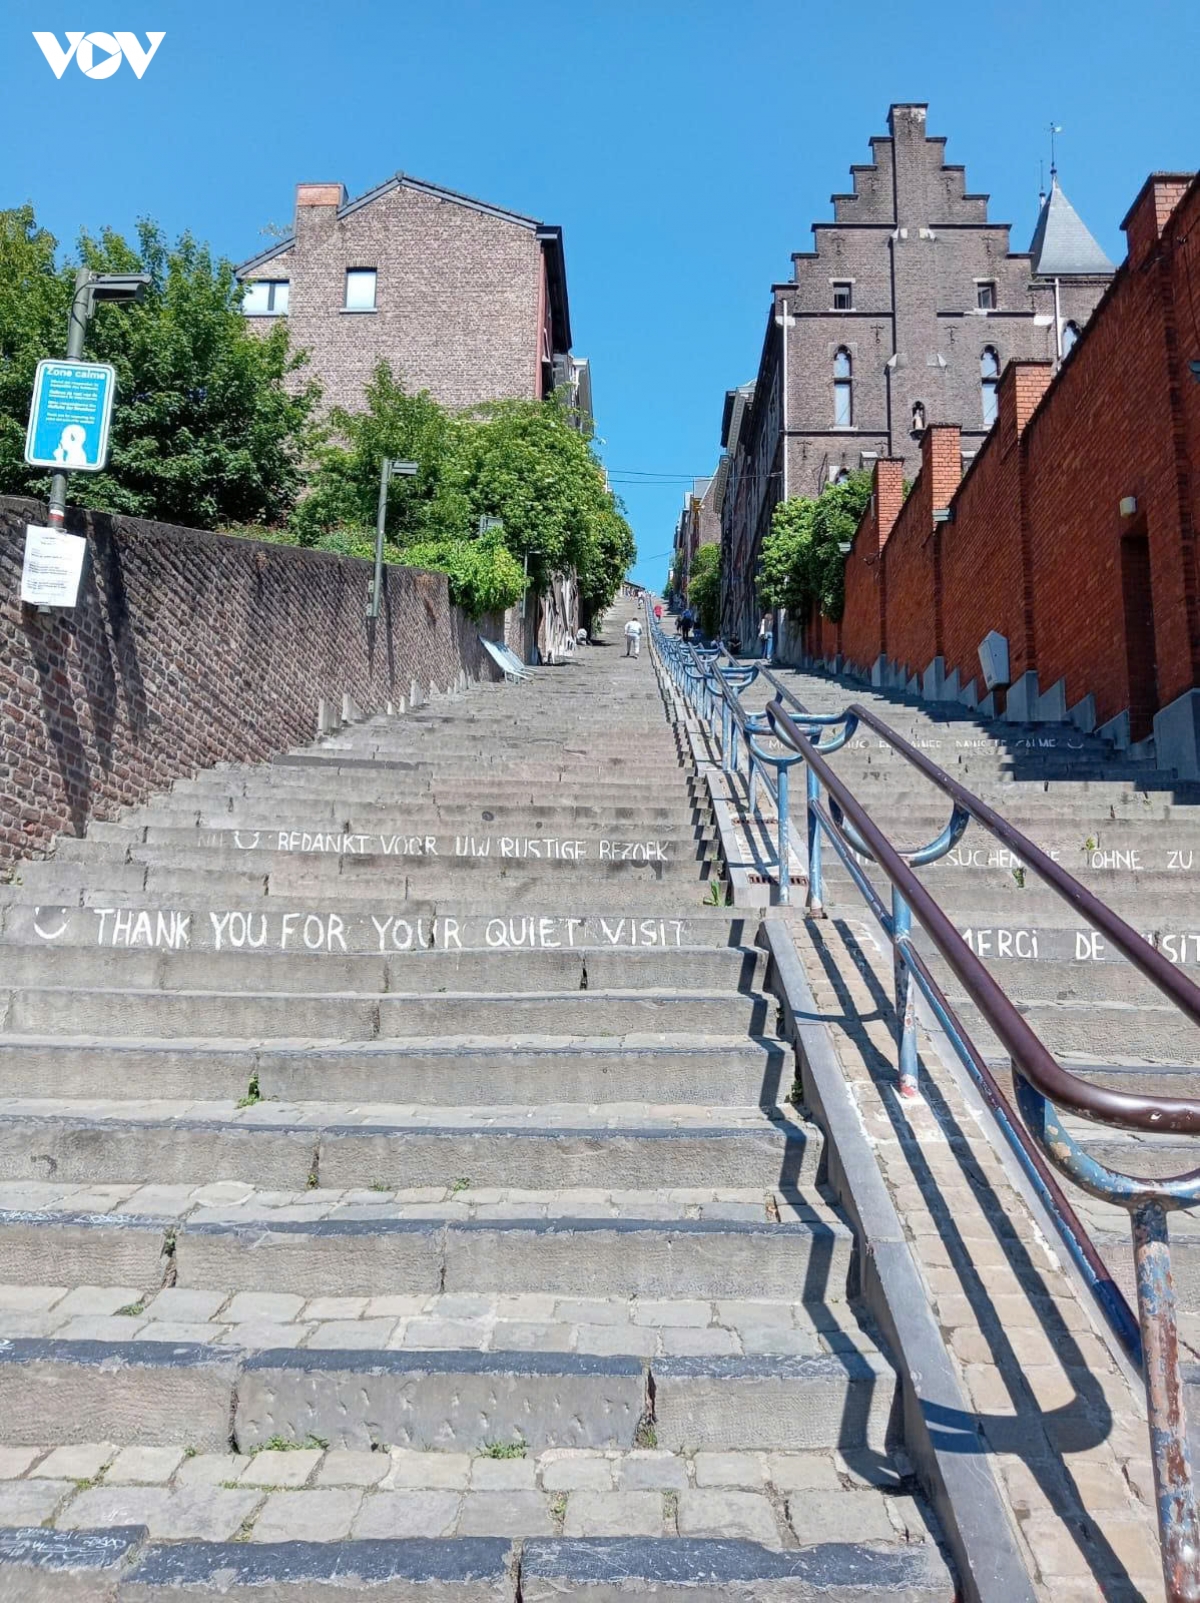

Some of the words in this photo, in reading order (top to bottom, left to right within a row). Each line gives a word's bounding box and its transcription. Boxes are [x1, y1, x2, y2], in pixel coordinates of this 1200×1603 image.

[47, 365, 73, 378] Zone
[75, 368, 106, 380] calme
[1092, 850, 1144, 869] OHNE
[1166, 850, 1193, 869] ZU
[94, 908, 191, 949] THANK
[209, 911, 267, 950] YOU
[281, 913, 347, 951] FOR
[371, 916, 462, 952] YOUR
[1075, 931, 1105, 960] DE
